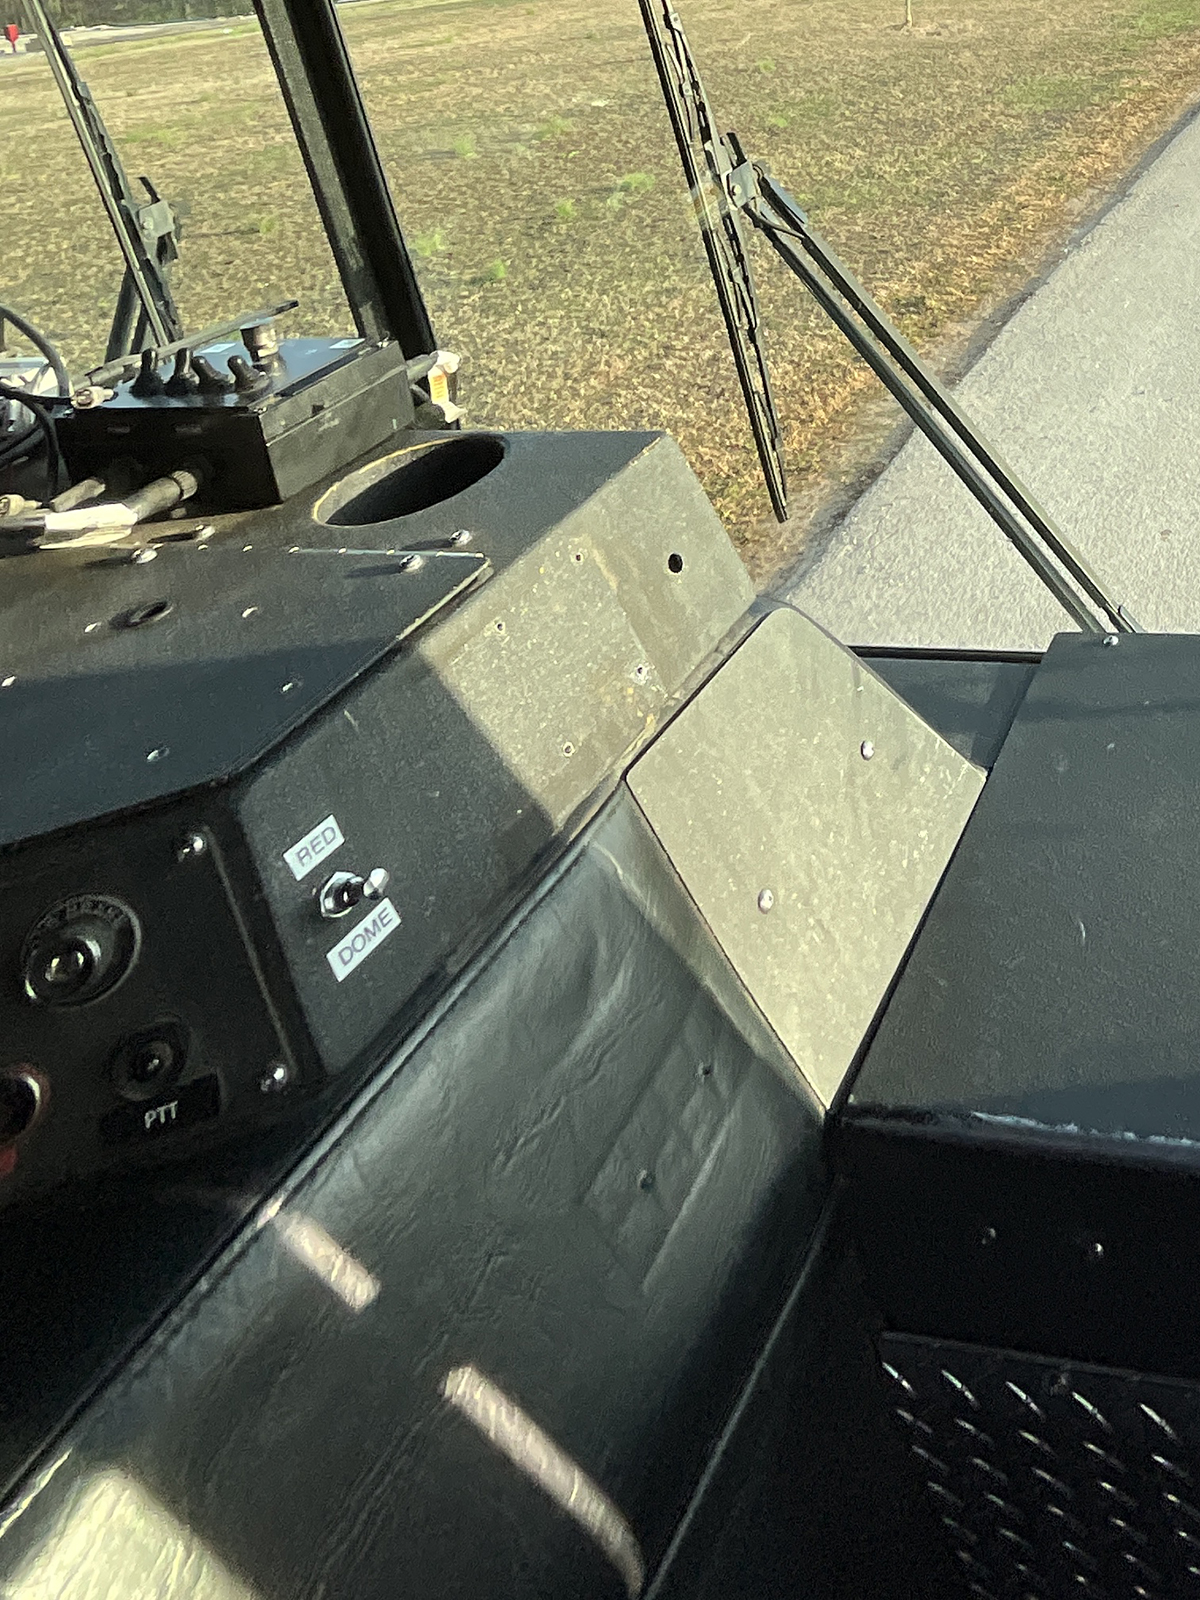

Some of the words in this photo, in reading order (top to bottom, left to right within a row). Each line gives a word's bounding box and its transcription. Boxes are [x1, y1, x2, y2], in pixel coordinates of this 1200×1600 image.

[295, 825, 338, 867] RED
[338, 909, 393, 968] DOME
[144, 1100, 179, 1129] PTT
